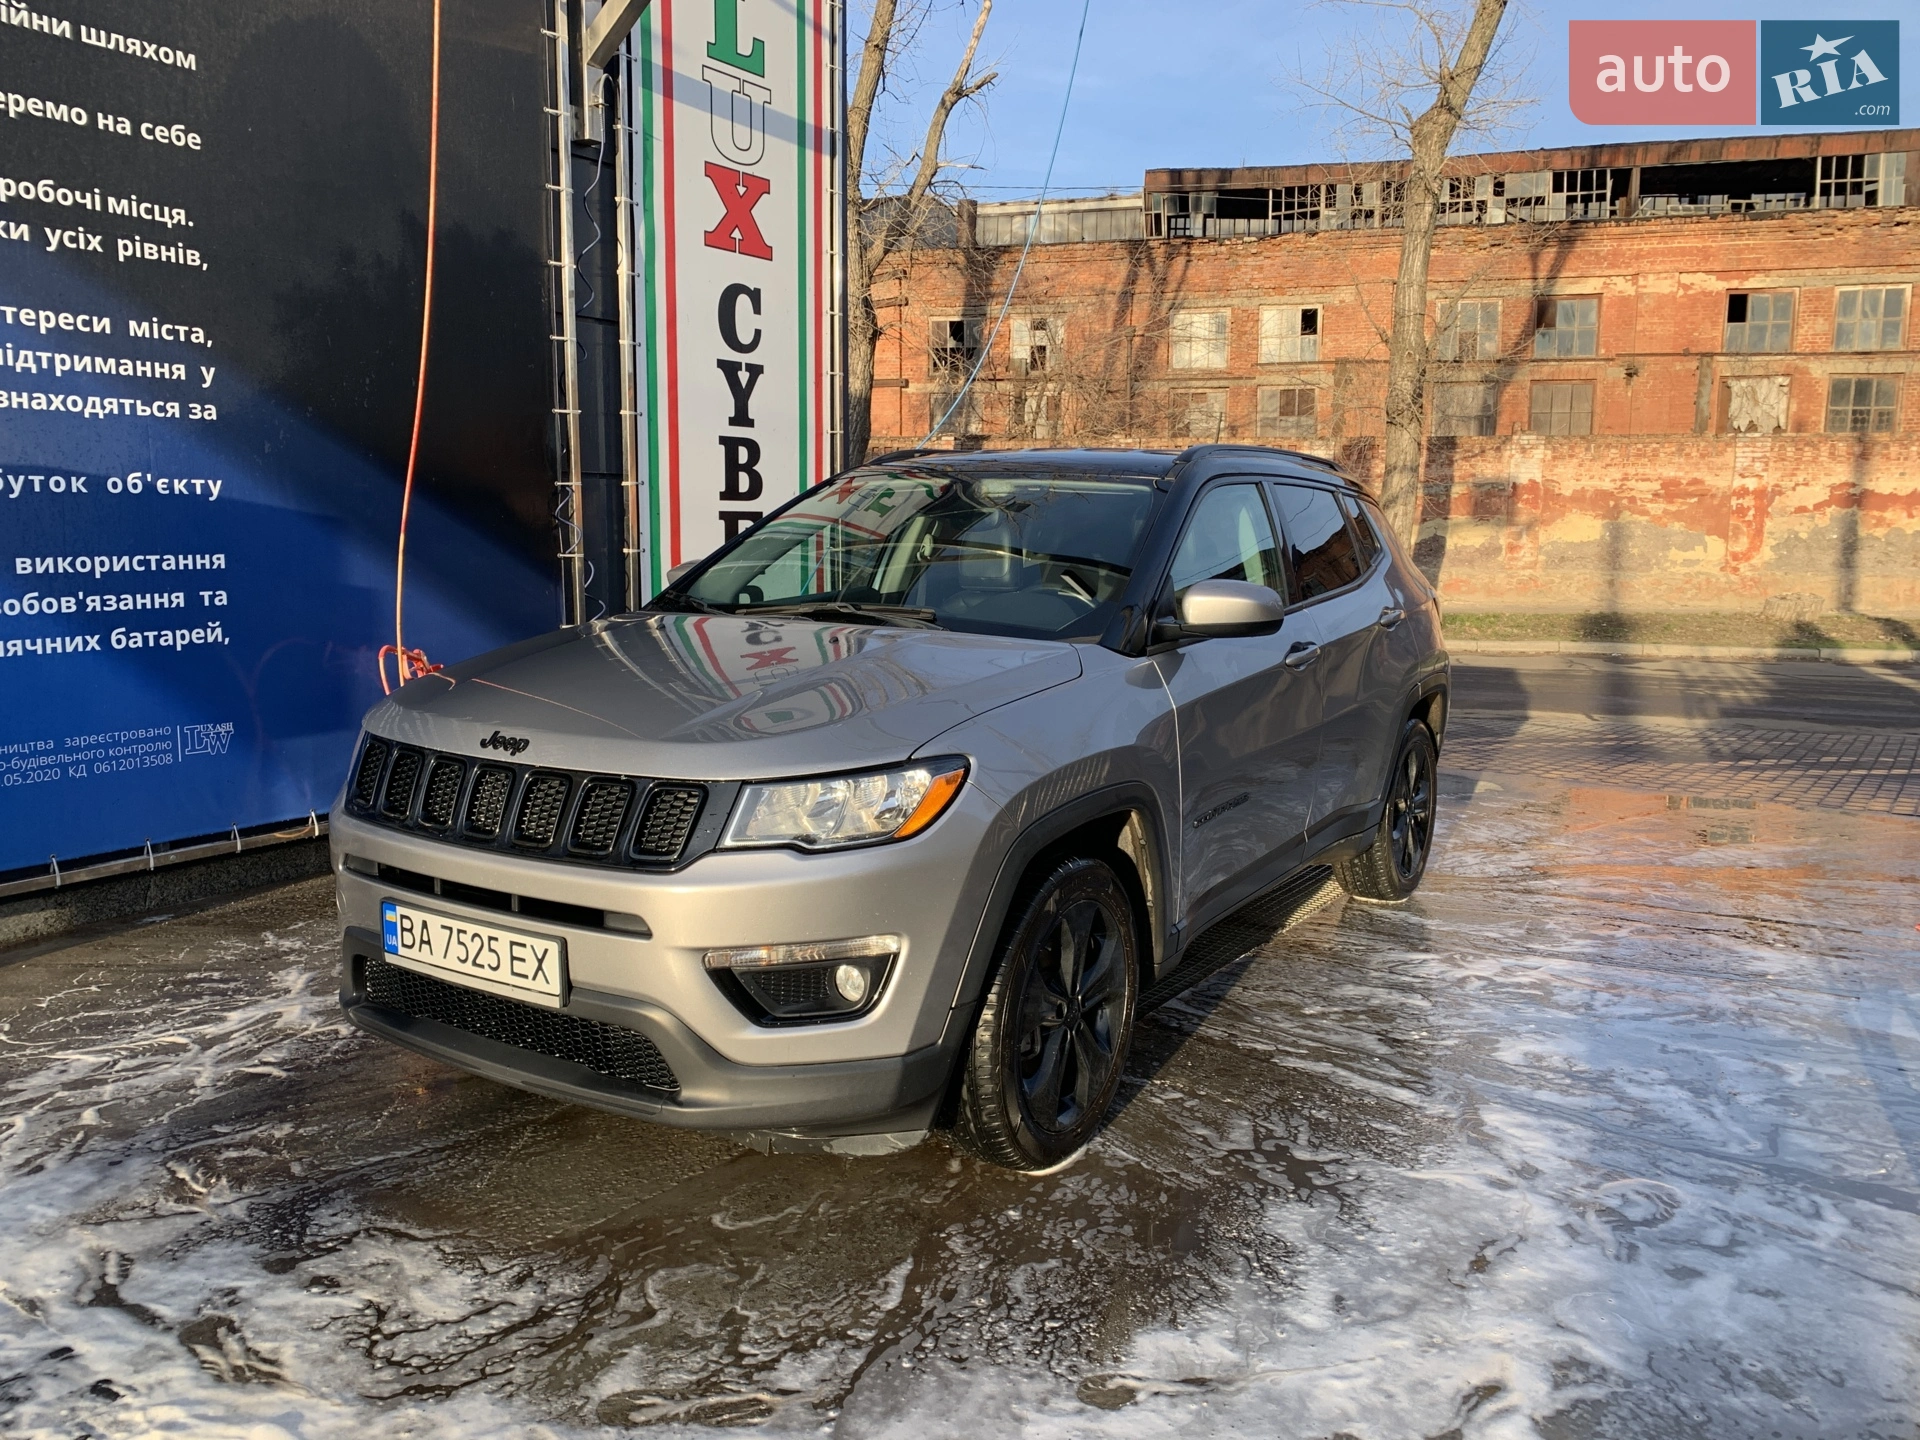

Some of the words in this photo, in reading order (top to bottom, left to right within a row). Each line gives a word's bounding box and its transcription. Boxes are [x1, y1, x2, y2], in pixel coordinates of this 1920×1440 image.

[80, 25, 197, 71] шляхом
[97, 112, 131, 136] на
[140, 121, 202, 150] себе
[702, 0, 772, 261] LUX
[0, 177, 101, 211] робочі
[107, 194, 195, 228] місця.
[44, 226, 103, 251] усіх
[117, 236, 209, 271] рівнів,
[0, 305, 111, 334] тереси
[129, 317, 213, 348] міста,
[0, 342, 187, 381] ідтримання
[200, 365, 216, 388] у
[189, 402, 217, 420] за
[0, 468, 88, 498] уток
[106, 472, 222, 501] об'єкту
[15, 553, 226, 578] використання
[0, 591, 185, 616] обов'язання
[199, 590, 228, 606] та
[0, 634, 101, 657] ячних
[110, 621, 230, 651] батарей,
[64, 726, 172, 748] зареєстровано
[109, 740, 172, 758] контролю
[480, 731, 530, 756] Jeep
[68, 765, 87, 778] КД
[93, 753, 173, 774] 0612013508
[386, 934, 398, 947] UA
[399, 914, 433, 956] BA
[440, 925, 501, 971] 7525
[509, 940, 550, 984] EX
